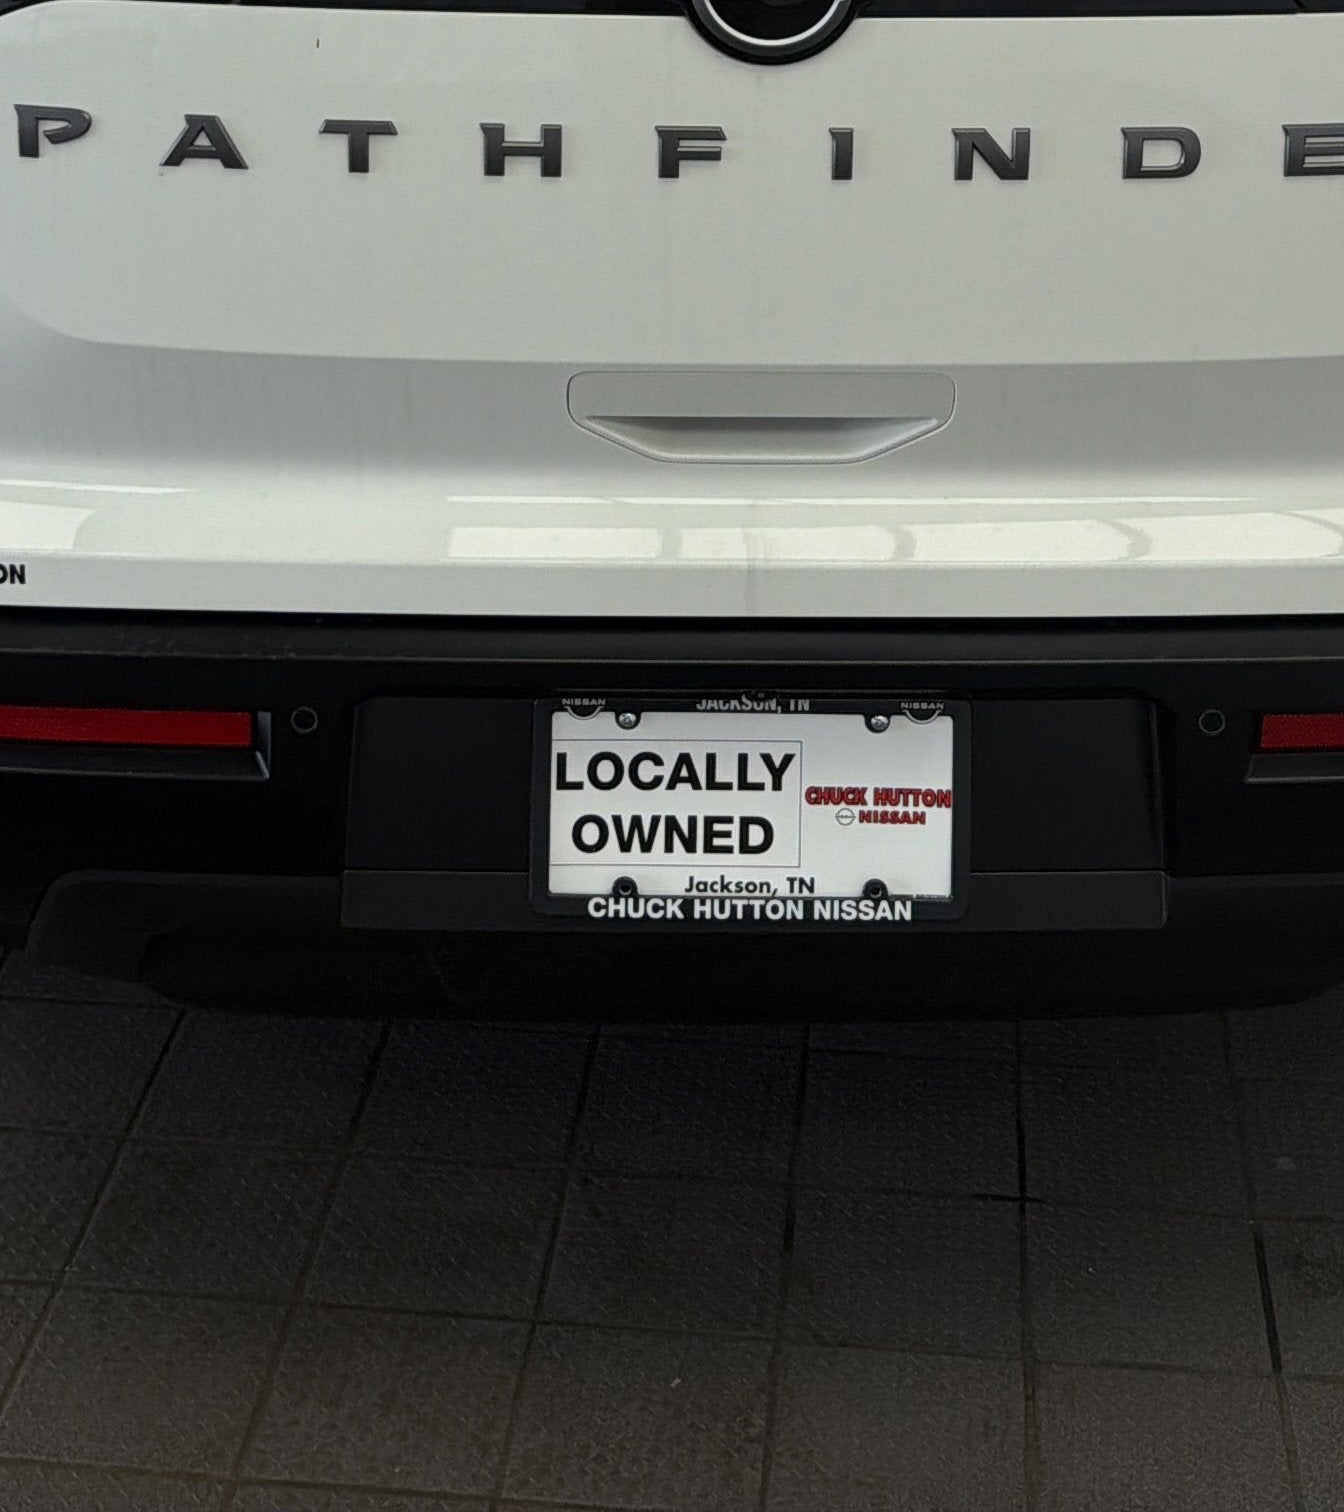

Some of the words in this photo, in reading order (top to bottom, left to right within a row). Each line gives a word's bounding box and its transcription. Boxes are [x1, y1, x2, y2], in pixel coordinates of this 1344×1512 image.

[556, 752, 796, 791] LOCALLY
[805, 786, 868, 806] CHUCK
[873, 788, 952, 808] HUTTON
[858, 810, 926, 825] NISSAN
[571, 815, 774, 854] OWNED
[684, 876, 777, 897] Jackson,
[785, 878, 815, 894] TN
[587, 897, 685, 920] CHUCK
[693, 899, 806, 920] HUTTON
[813, 900, 912, 921] NISSAN
